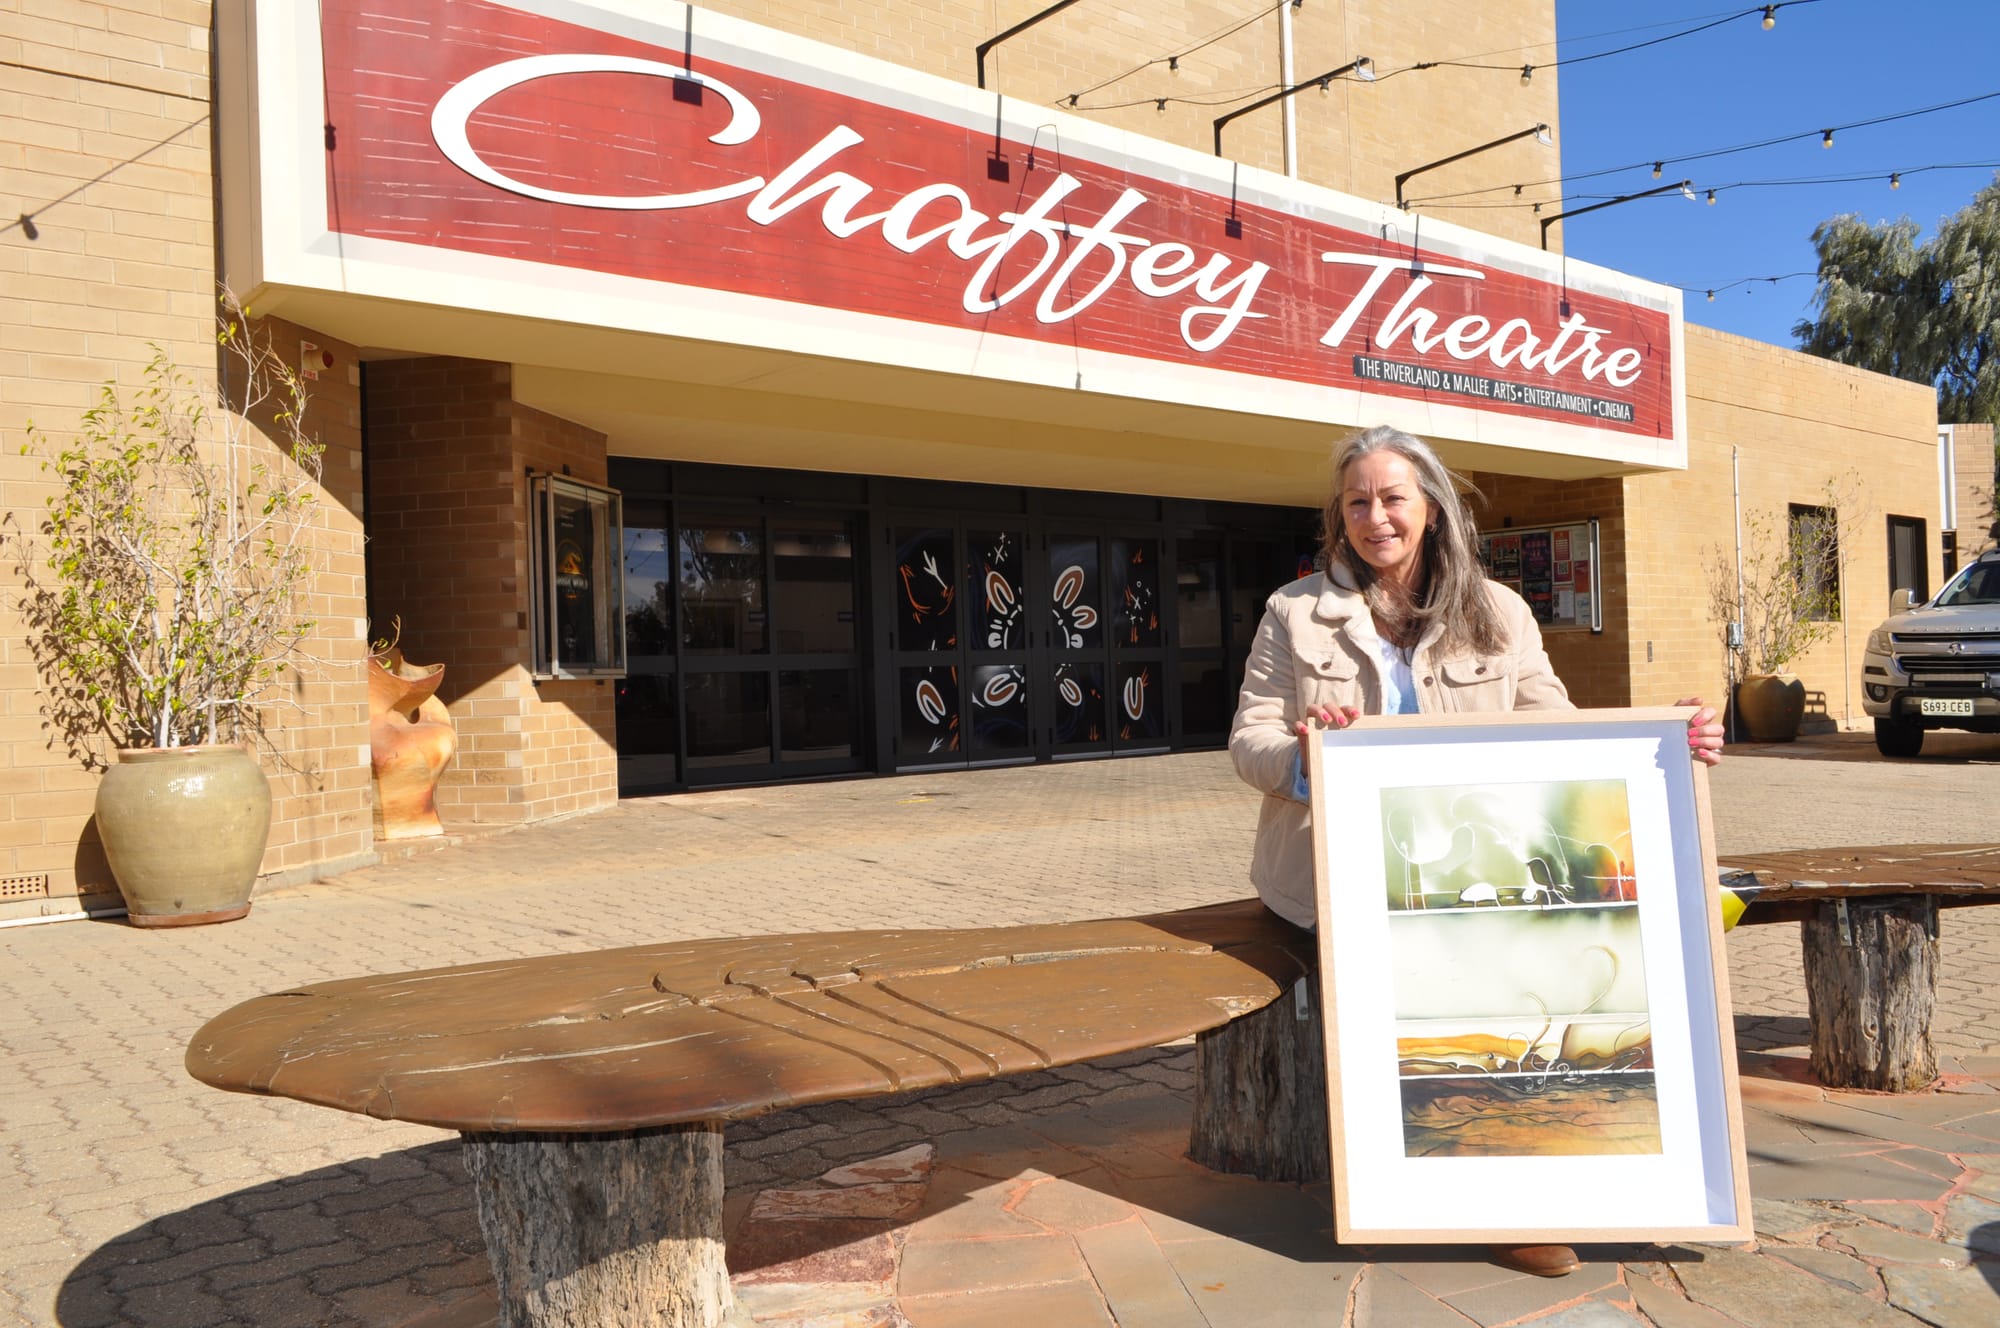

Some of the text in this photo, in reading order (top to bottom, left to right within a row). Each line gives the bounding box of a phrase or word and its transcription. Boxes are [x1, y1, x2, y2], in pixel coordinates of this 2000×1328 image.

[430, 53, 1642, 387] Chaffey Theatre
[1360, 358, 1381, 378] THE
[1383, 362, 1440, 388] RIVERLAND
[1443, 373, 1451, 390] &
[1453, 374, 1490, 397] MALLEE
